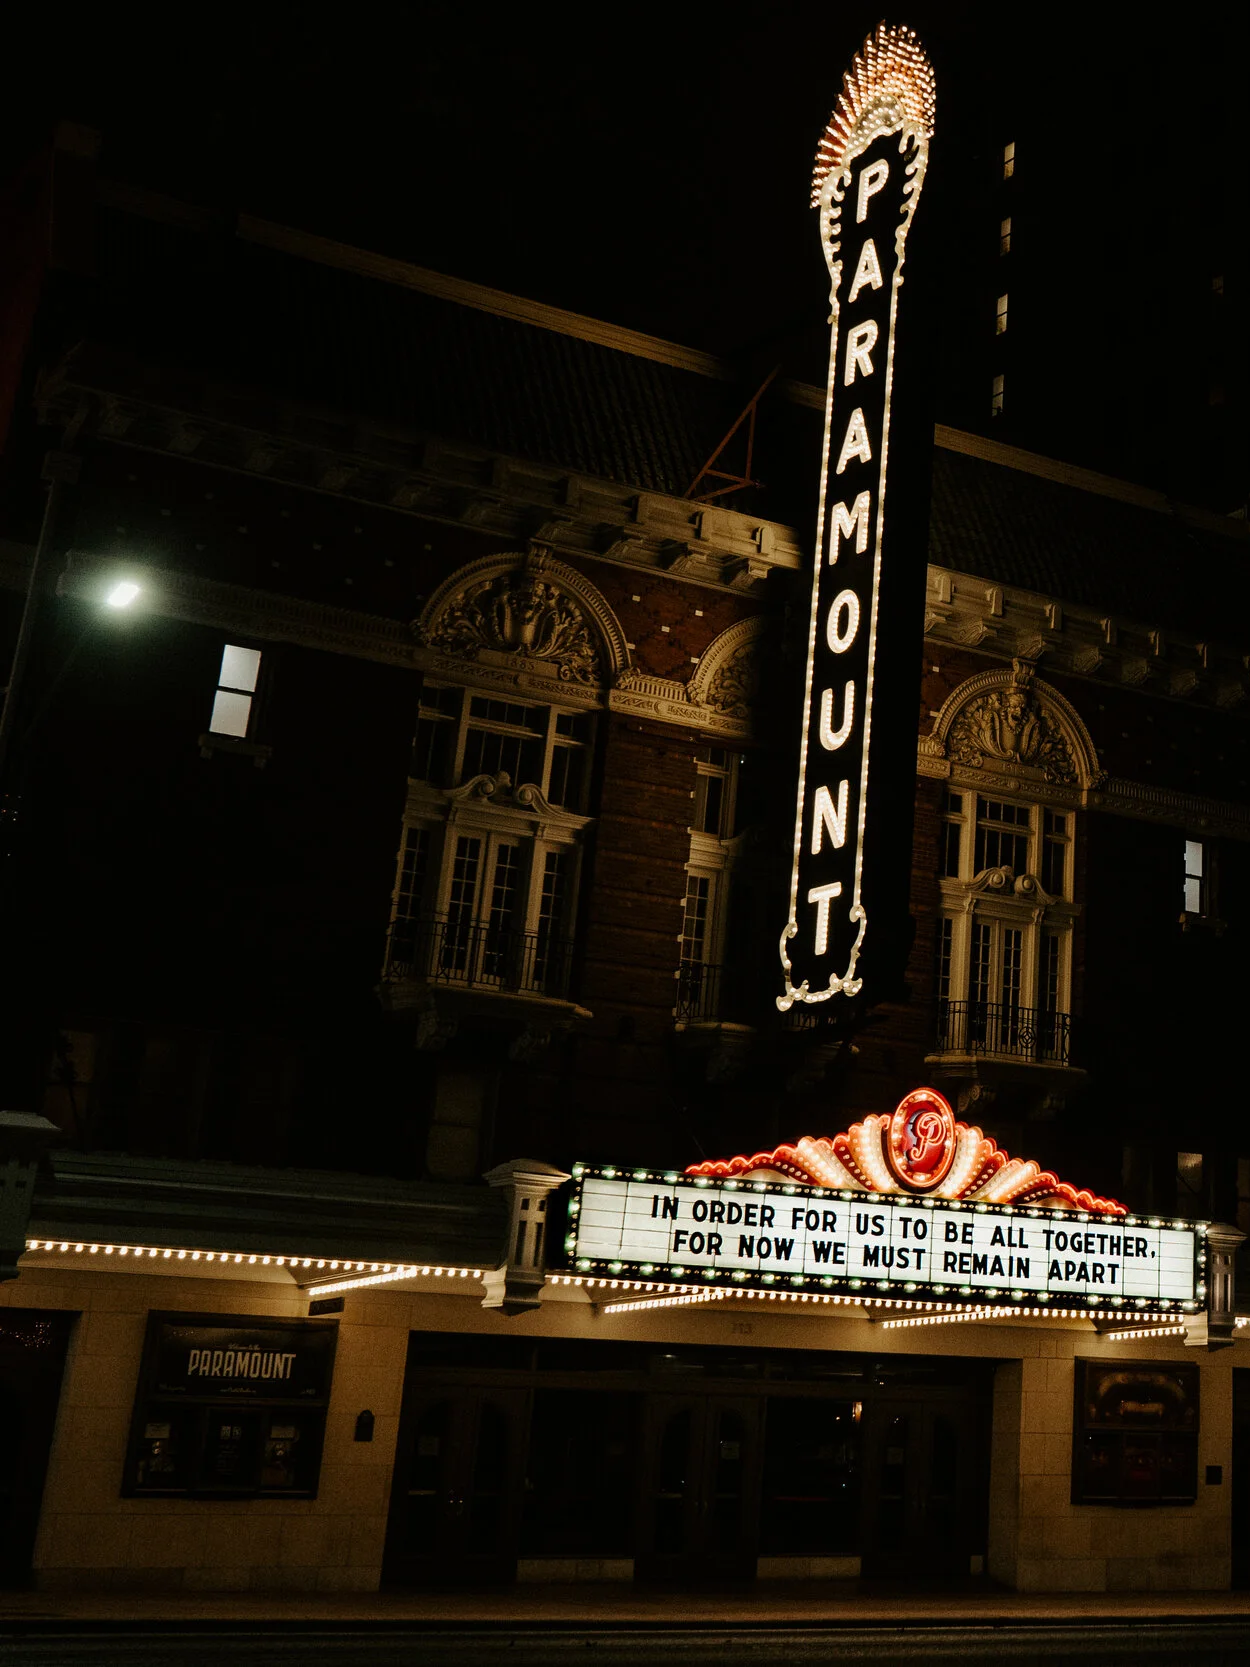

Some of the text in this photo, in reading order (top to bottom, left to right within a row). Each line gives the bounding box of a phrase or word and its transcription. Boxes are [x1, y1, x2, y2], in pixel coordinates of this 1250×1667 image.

[808, 159, 889, 956] PARAMOUNT
[911, 1112, 946, 1161] P
[651, 1194, 1157, 1259] IN ORDER FOR US TO BE ALL TOGETHER,
[673, 1229, 1120, 1285] FOR NOW WE MUST REMAIN APART
[187, 1349, 297, 1380] PARAMOUNT
